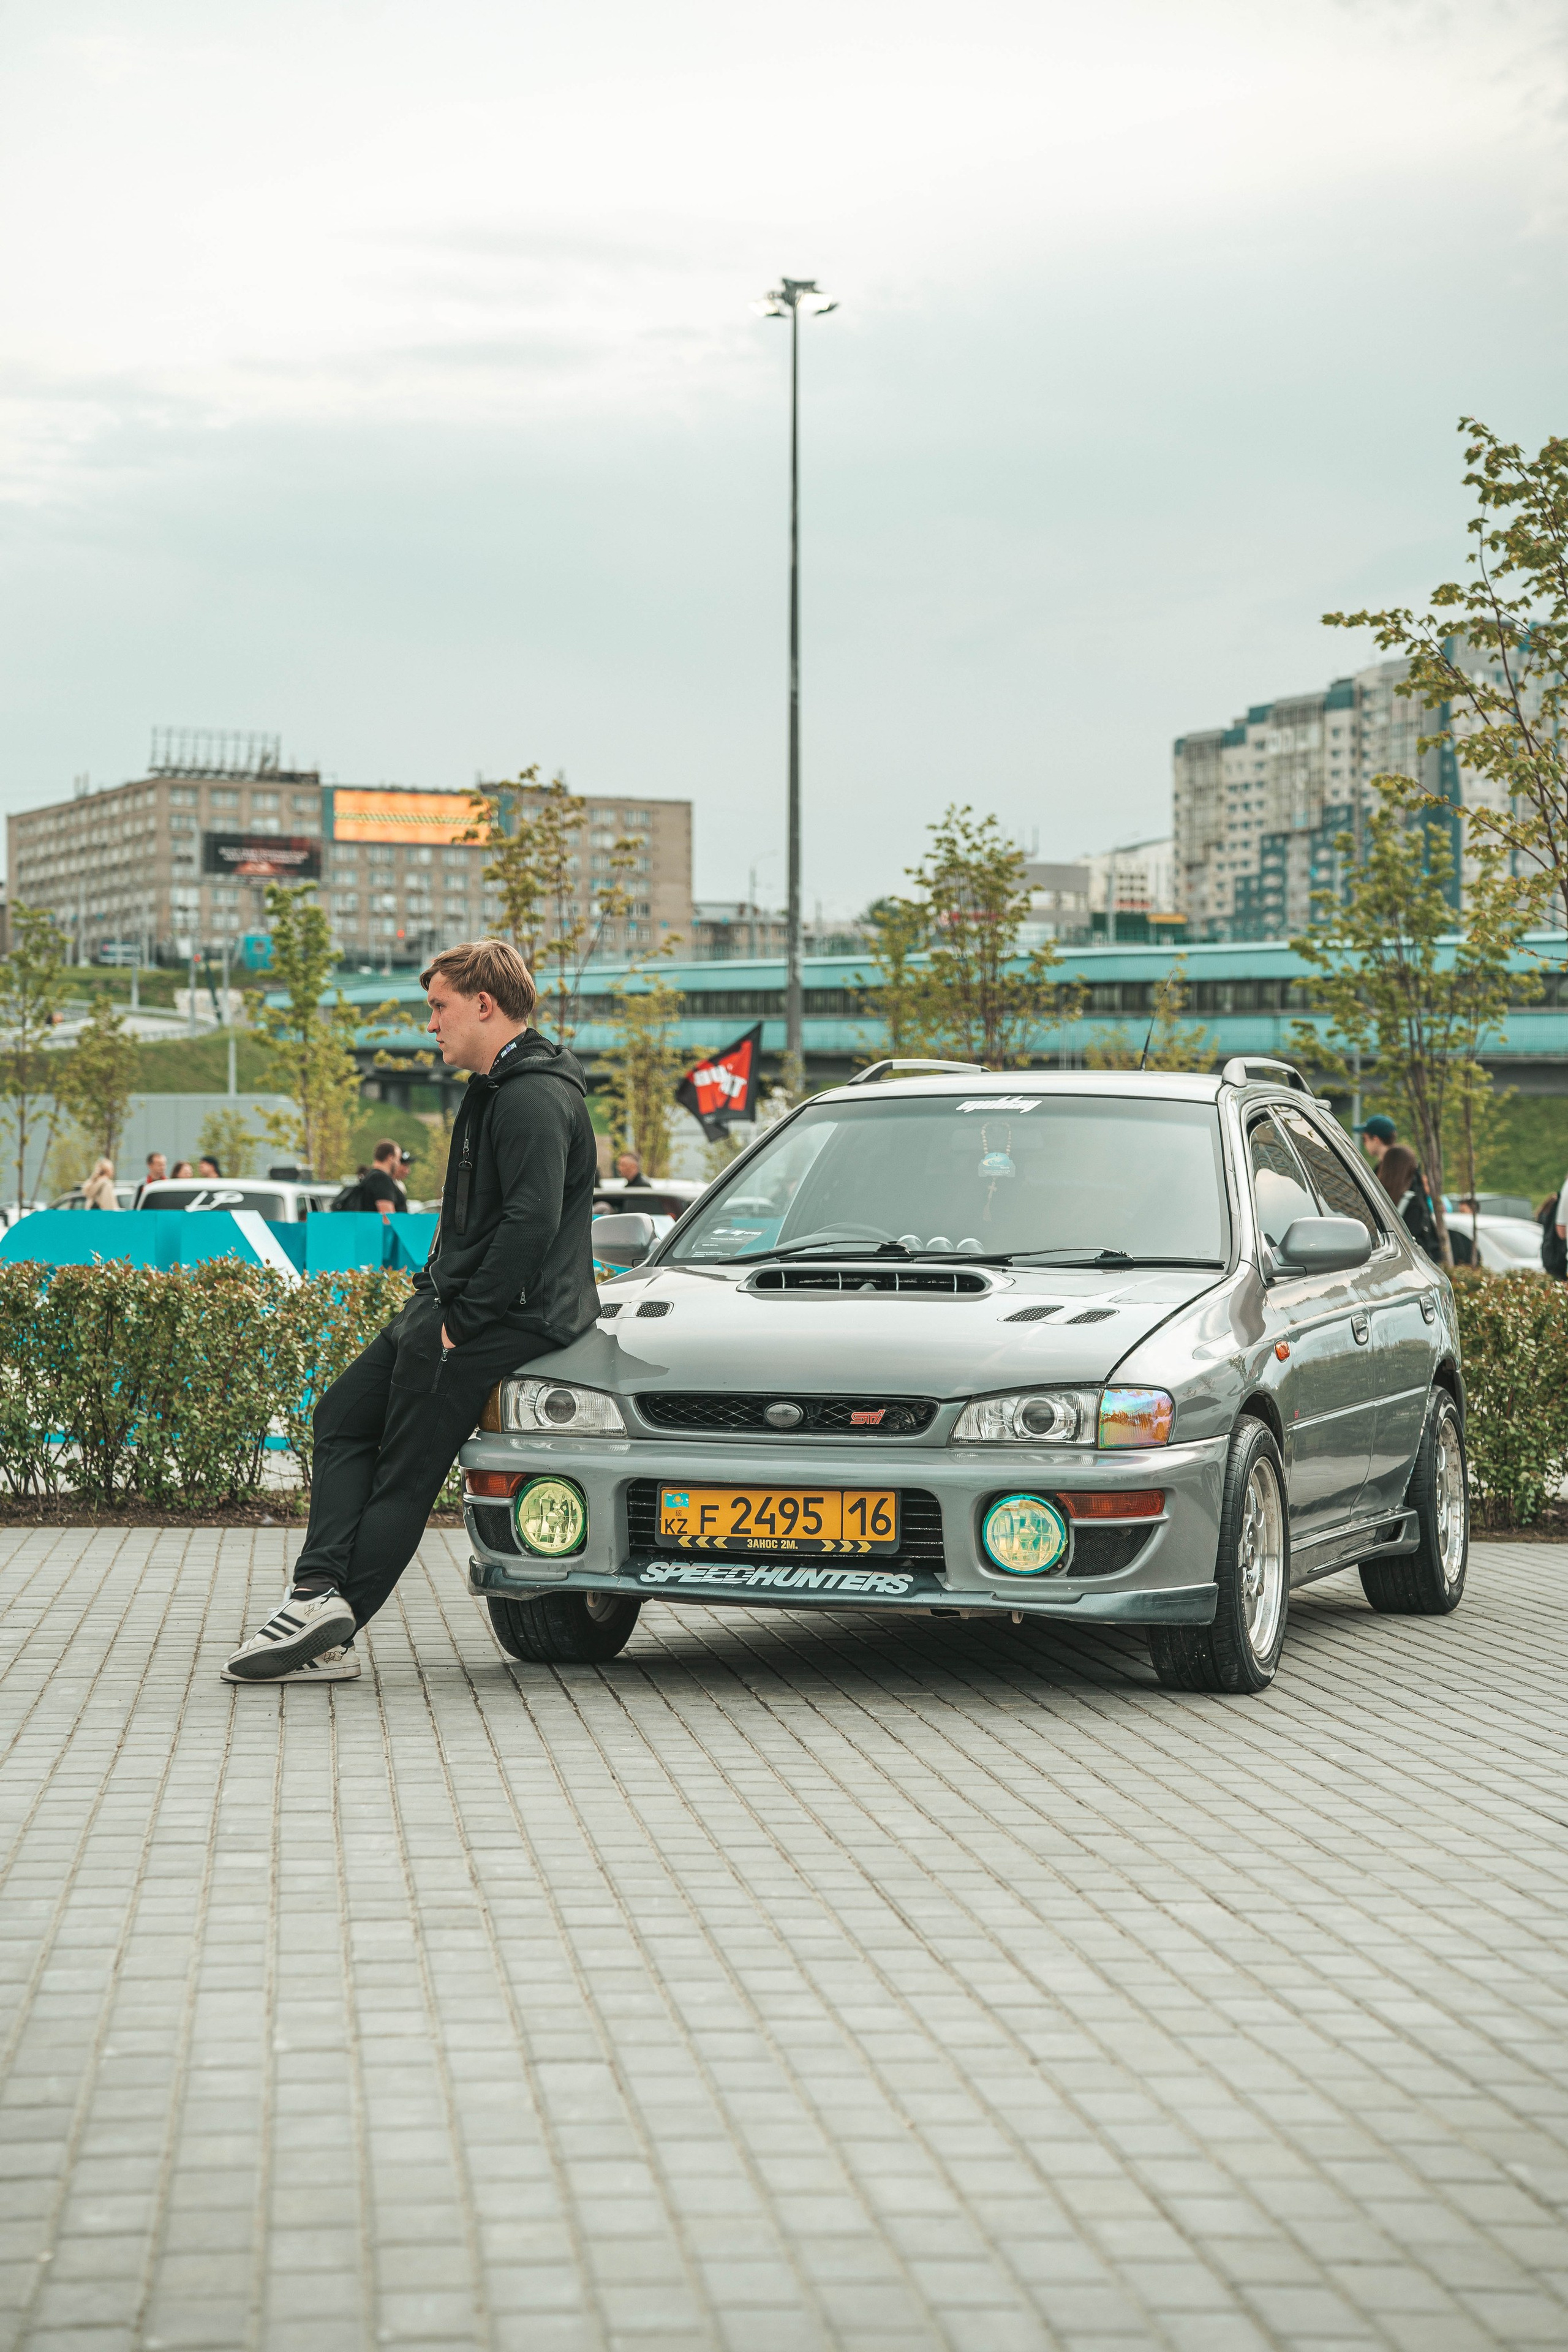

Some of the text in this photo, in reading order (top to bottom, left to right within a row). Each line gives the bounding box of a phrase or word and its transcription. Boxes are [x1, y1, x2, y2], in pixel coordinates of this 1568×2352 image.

[701, 1497, 892, 1536] F 2495 16
[665, 1518, 687, 1534] KZ
[747, 1539, 798, 1549] ЗАНОС 2М.
